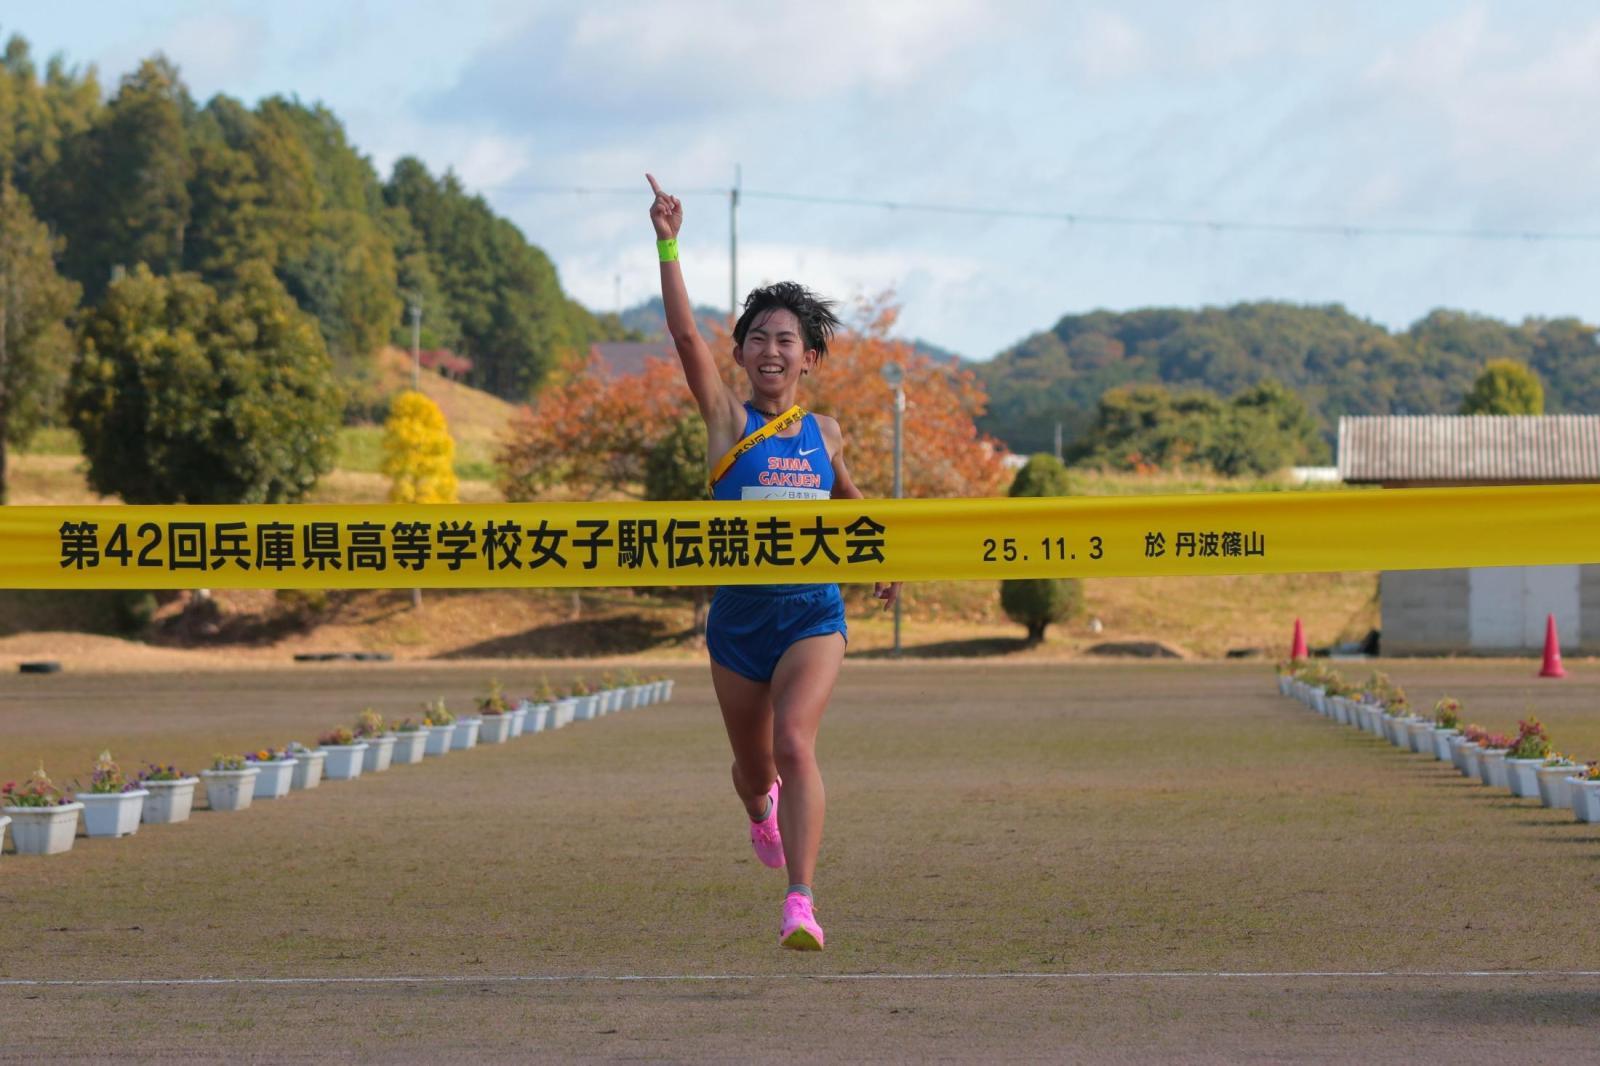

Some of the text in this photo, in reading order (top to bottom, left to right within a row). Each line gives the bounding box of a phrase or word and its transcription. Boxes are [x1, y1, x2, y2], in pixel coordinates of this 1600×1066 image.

[767, 456, 812, 472] SUMA
[758, 471, 821, 488] GAKUEN
[59, 516, 886, 572] 第42回兵庫県高等学校女子駅伝競走大会
[1144, 531, 1266, 558] 於 丹波篠山
